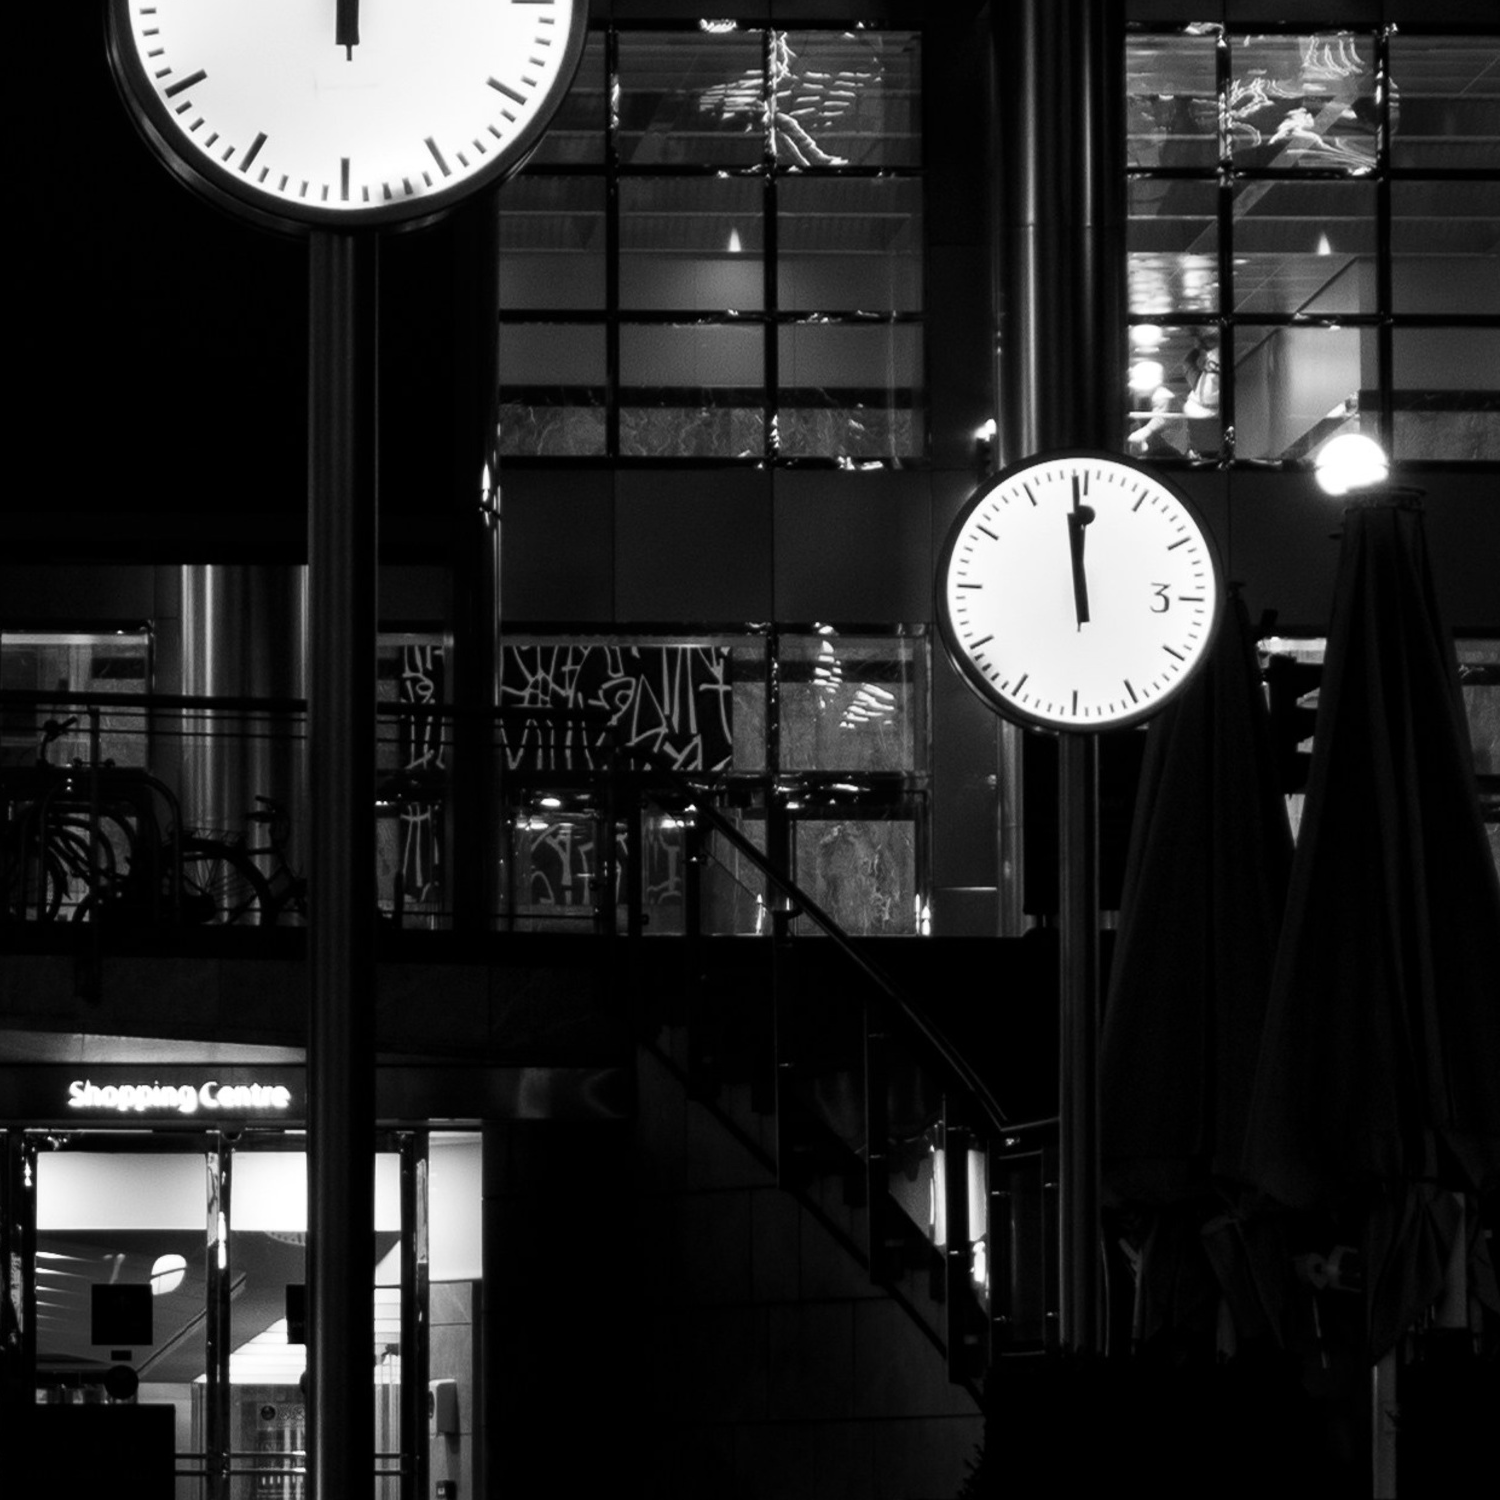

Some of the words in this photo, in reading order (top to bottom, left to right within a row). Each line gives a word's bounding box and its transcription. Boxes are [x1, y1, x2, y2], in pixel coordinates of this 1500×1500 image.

[1150, 582, 1171, 613] 3
[68, 1080, 197, 1113] Shopping
[199, 1081, 291, 1108] Centre
